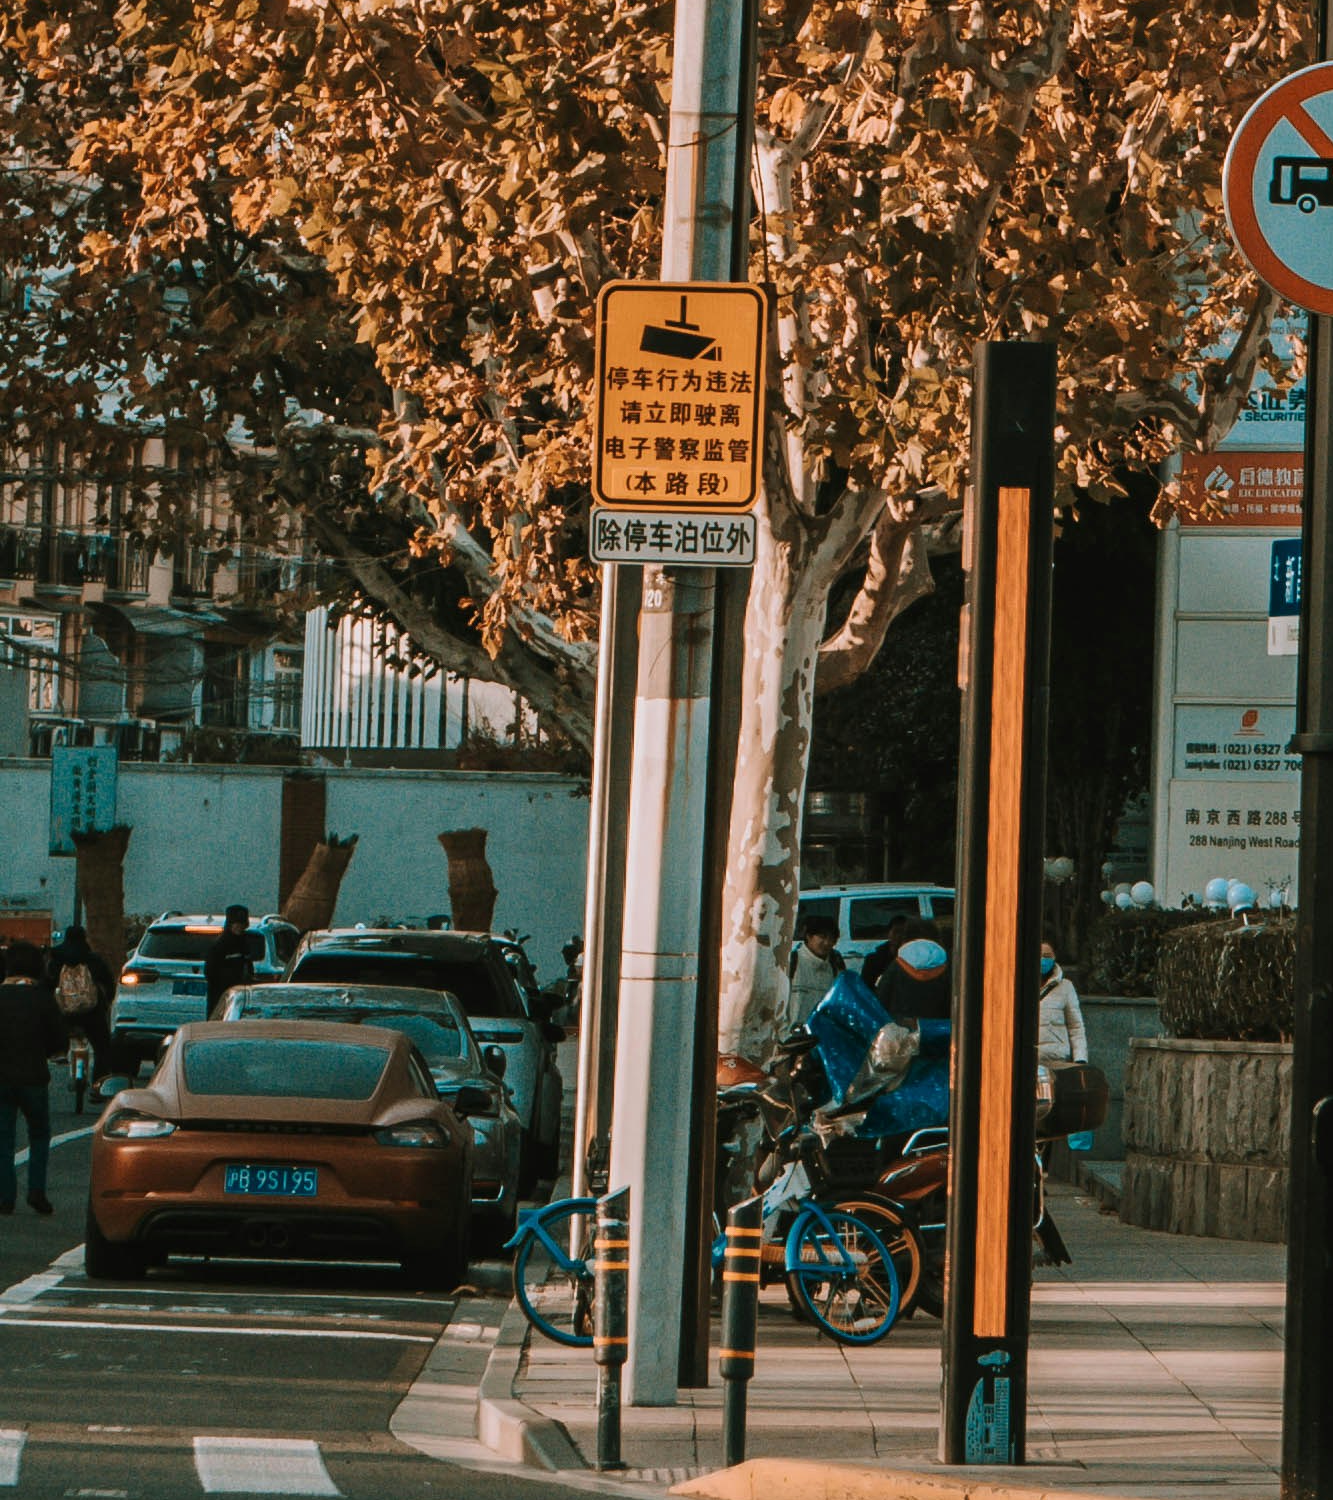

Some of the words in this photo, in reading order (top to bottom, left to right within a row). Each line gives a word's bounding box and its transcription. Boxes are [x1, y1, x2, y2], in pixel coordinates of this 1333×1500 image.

[607, 366, 752, 393] 停车行为违法
[620, 400, 741, 427] 请立即驶离
[1245, 411, 1306, 422] SECURITIE
[605, 436, 750, 463] 电子警察监管
[597, 518, 750, 556] 除停车泊位外
[1223, 743, 1252, 755] (021)
[1253, 744, 1281, 755] 6327
[1223, 760, 1252, 771] (021)
[1253, 760, 1281, 771] 6327
[1189, 835, 1207, 847] 288
[1209, 835, 1247, 850] Nanjing
[1249, 836, 1273, 848] West
